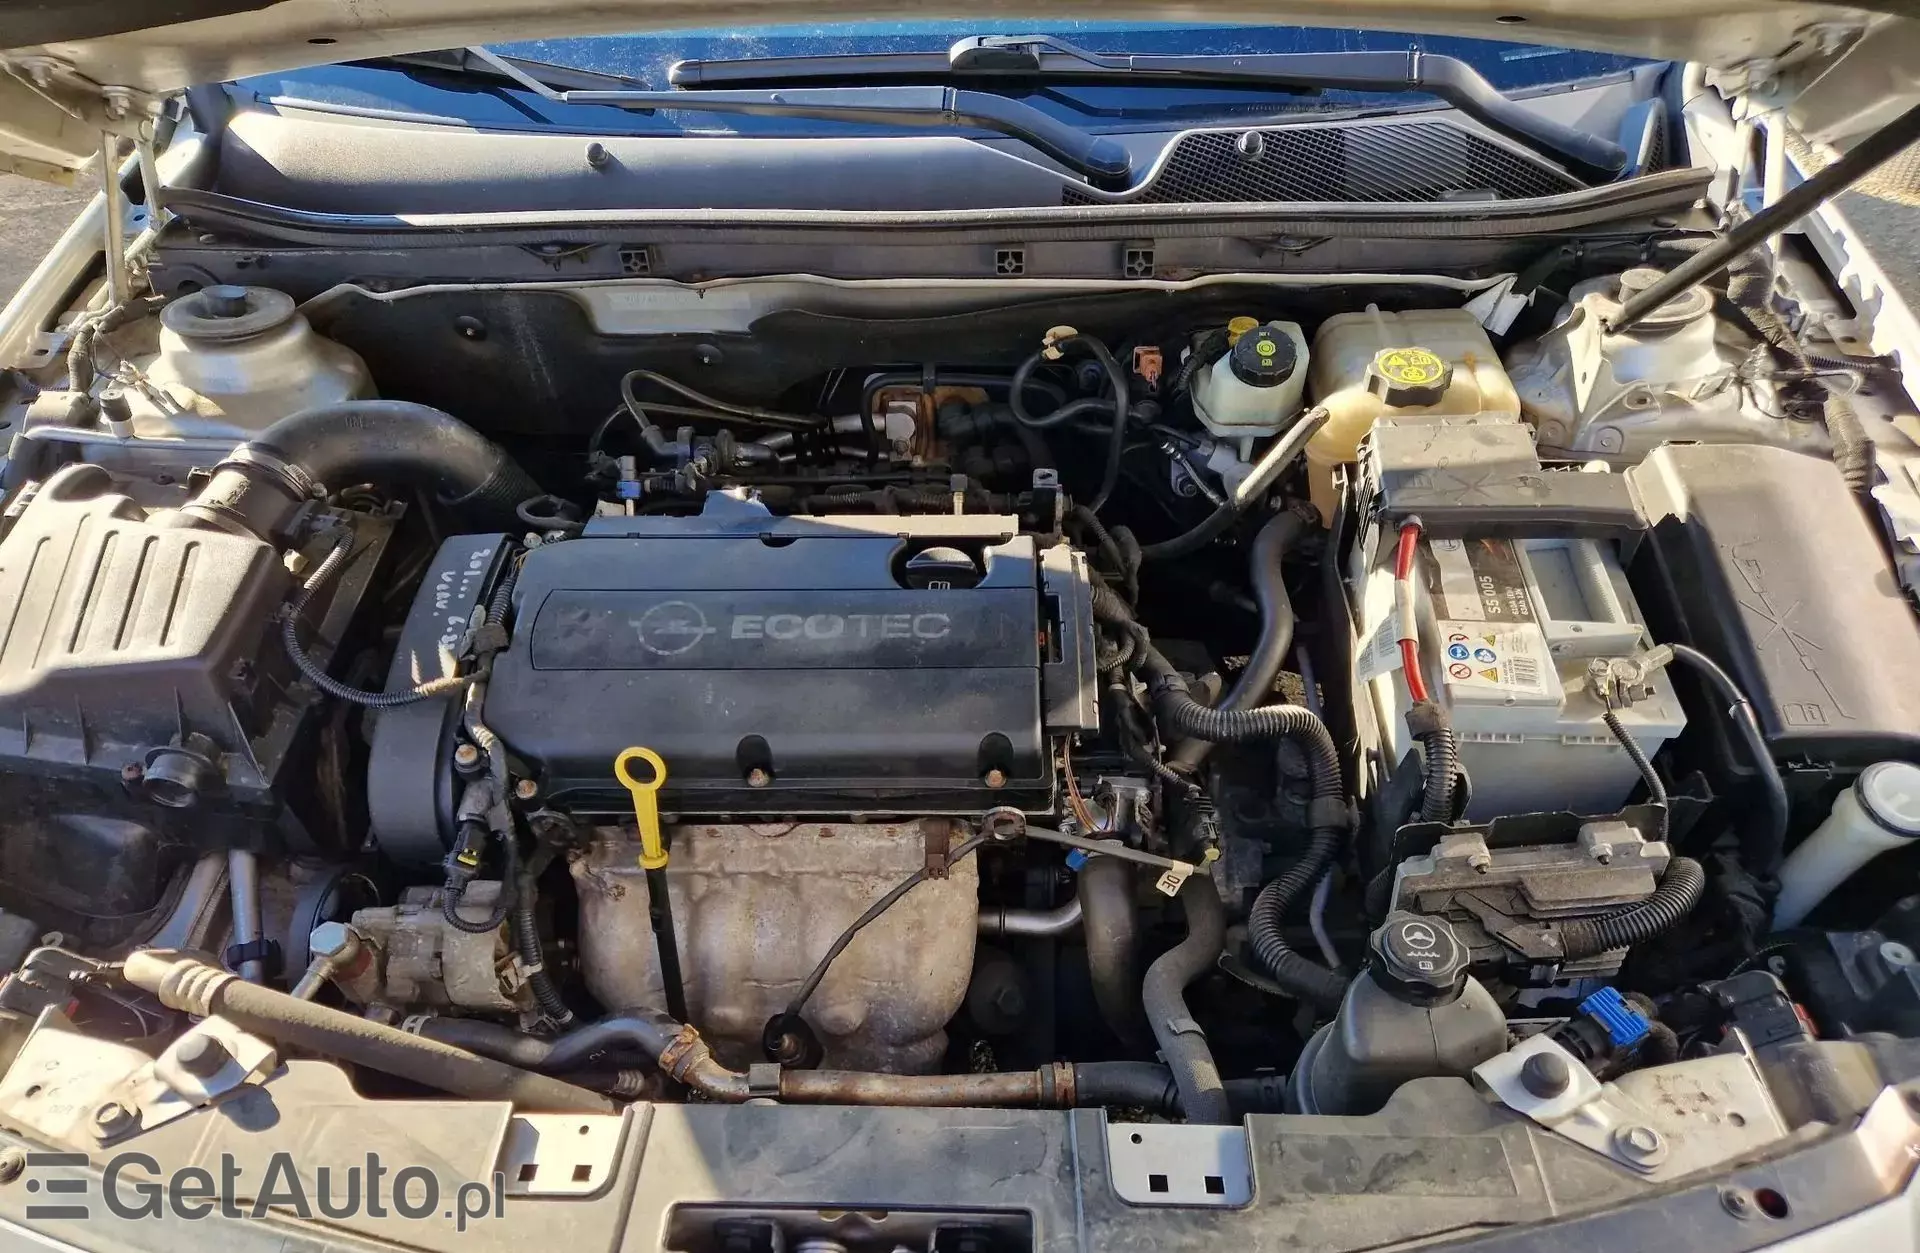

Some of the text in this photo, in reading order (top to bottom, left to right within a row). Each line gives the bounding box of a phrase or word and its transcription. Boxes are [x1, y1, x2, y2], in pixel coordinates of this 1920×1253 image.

[1478, 575, 1501, 614] S5 005
[731, 613, 951, 640] ECOTEC
[1161, 874, 1181, 893] DE
